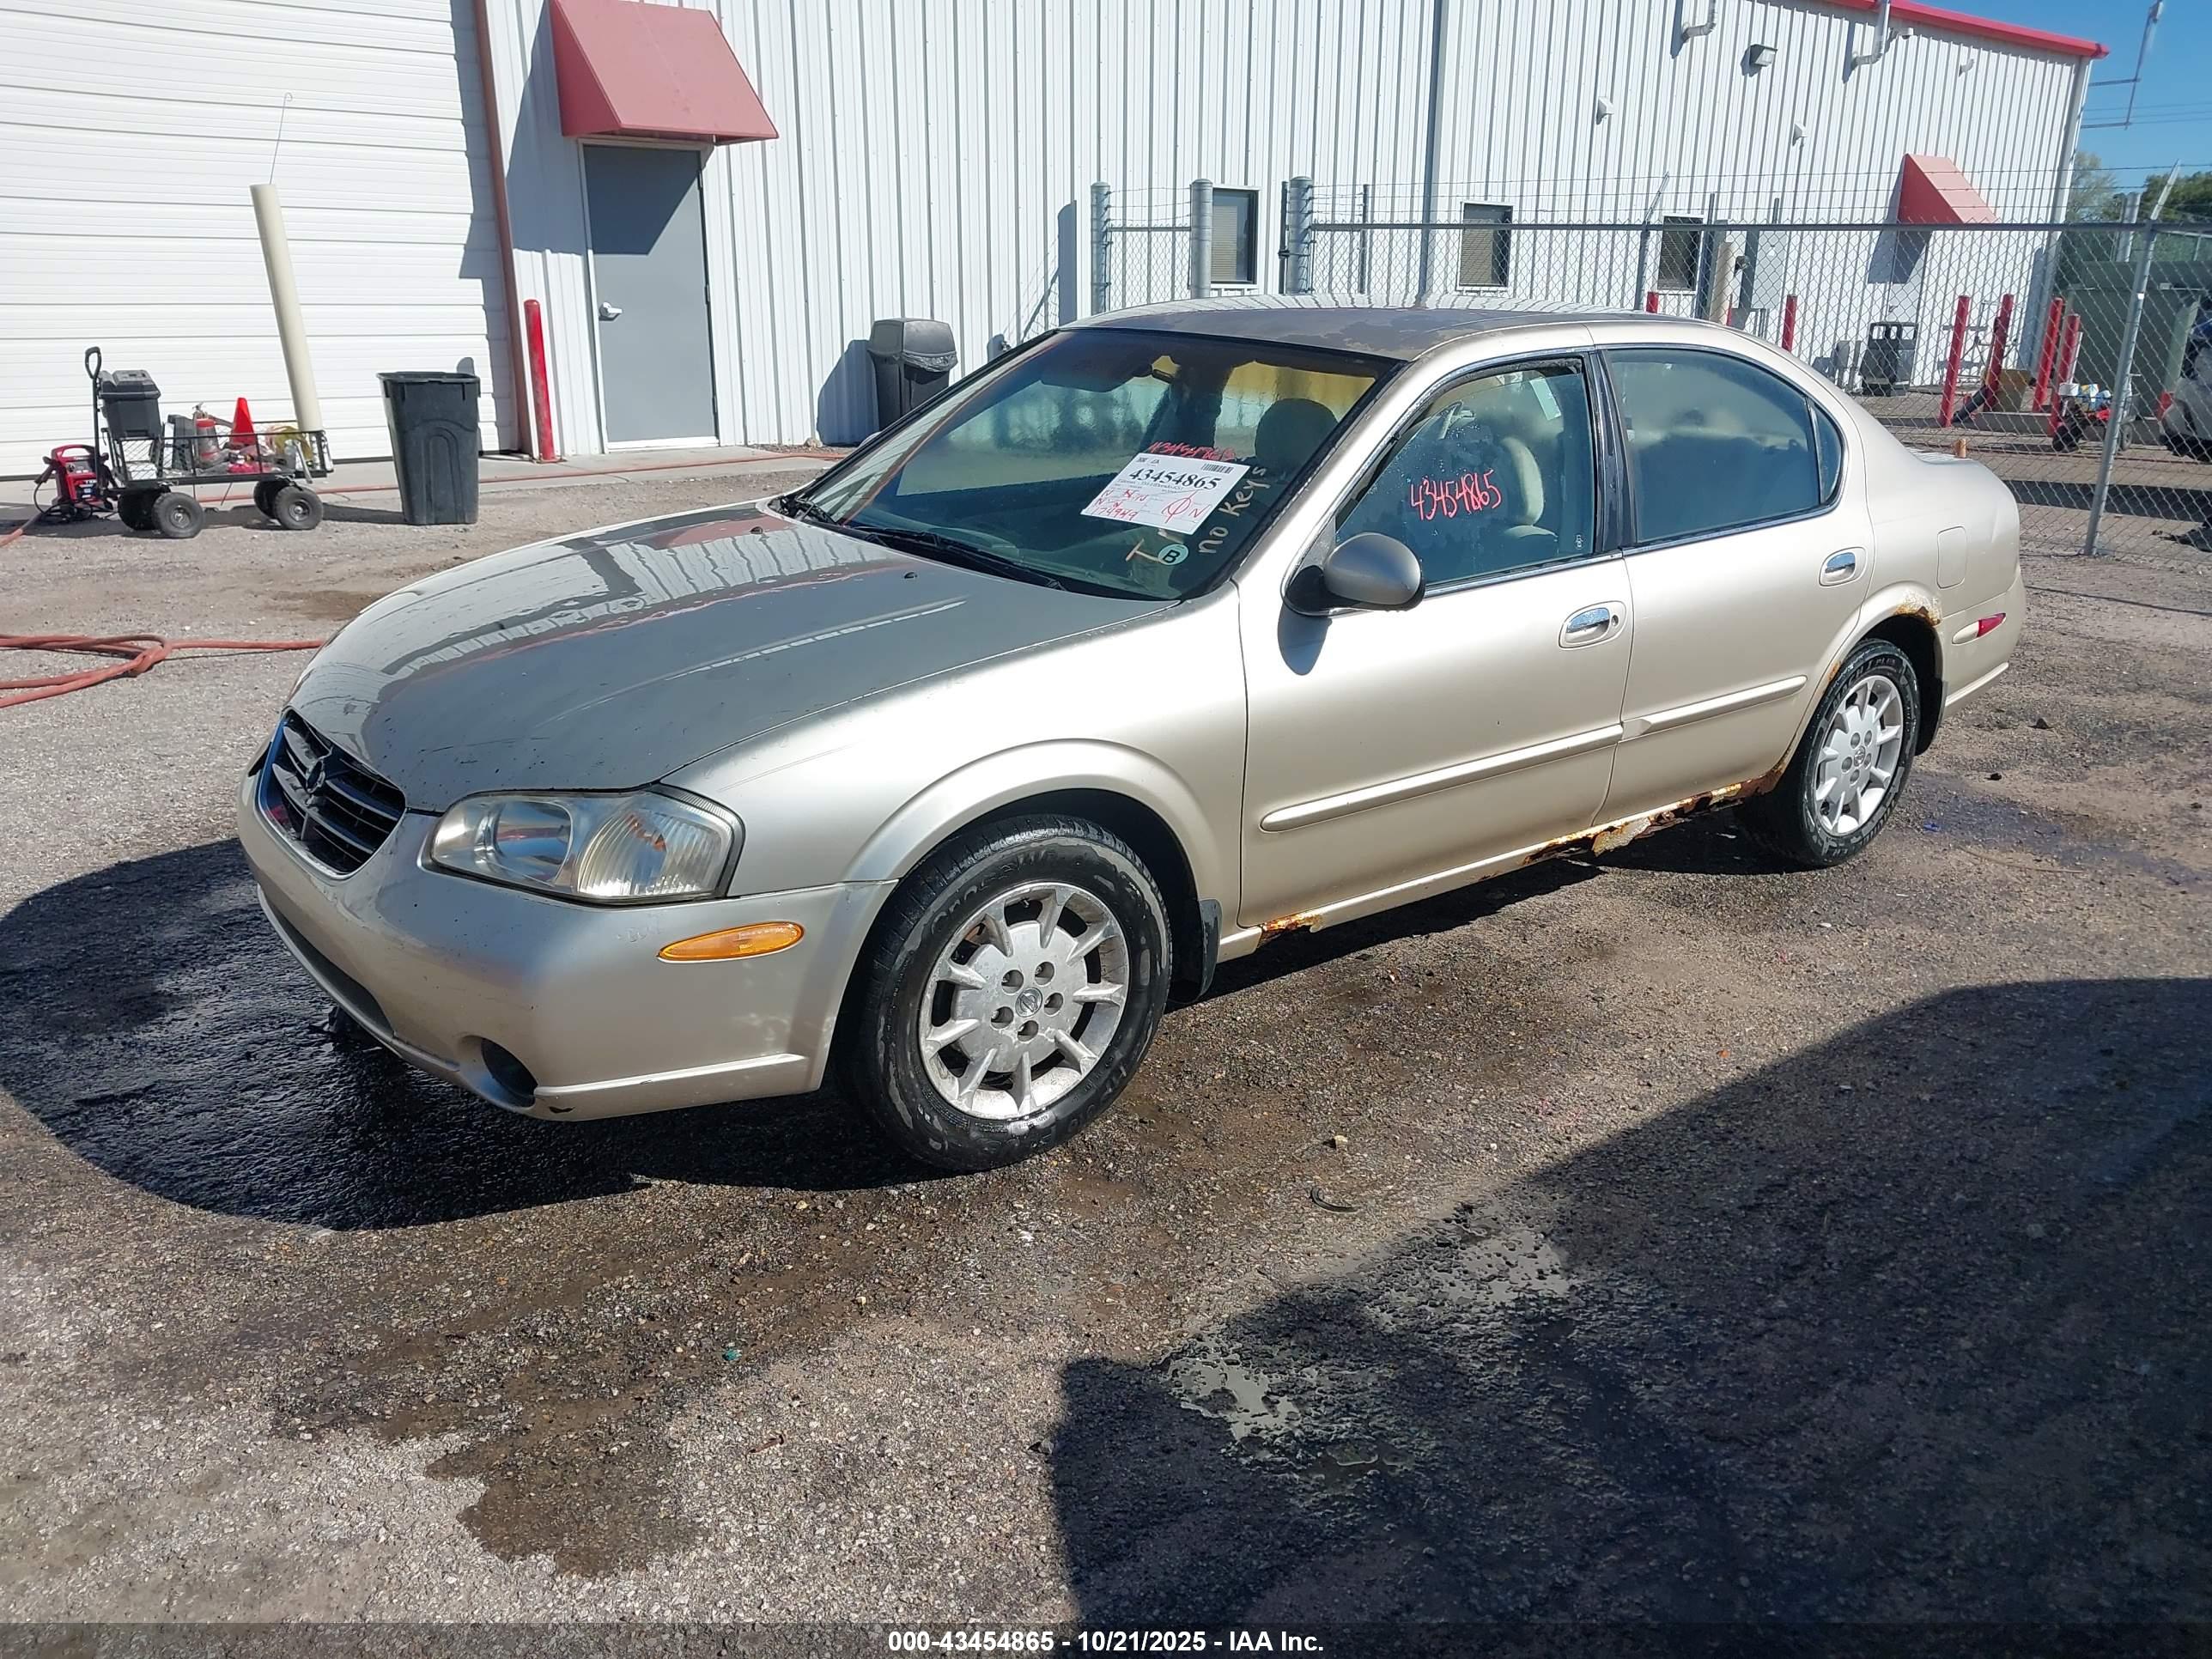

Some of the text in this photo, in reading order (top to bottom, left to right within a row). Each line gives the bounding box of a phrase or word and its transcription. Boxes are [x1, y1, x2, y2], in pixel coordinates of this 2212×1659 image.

[1129, 468, 1222, 490] 43454865
[1410, 469, 1502, 520] 43454865
[1163, 550, 1181, 563] B
